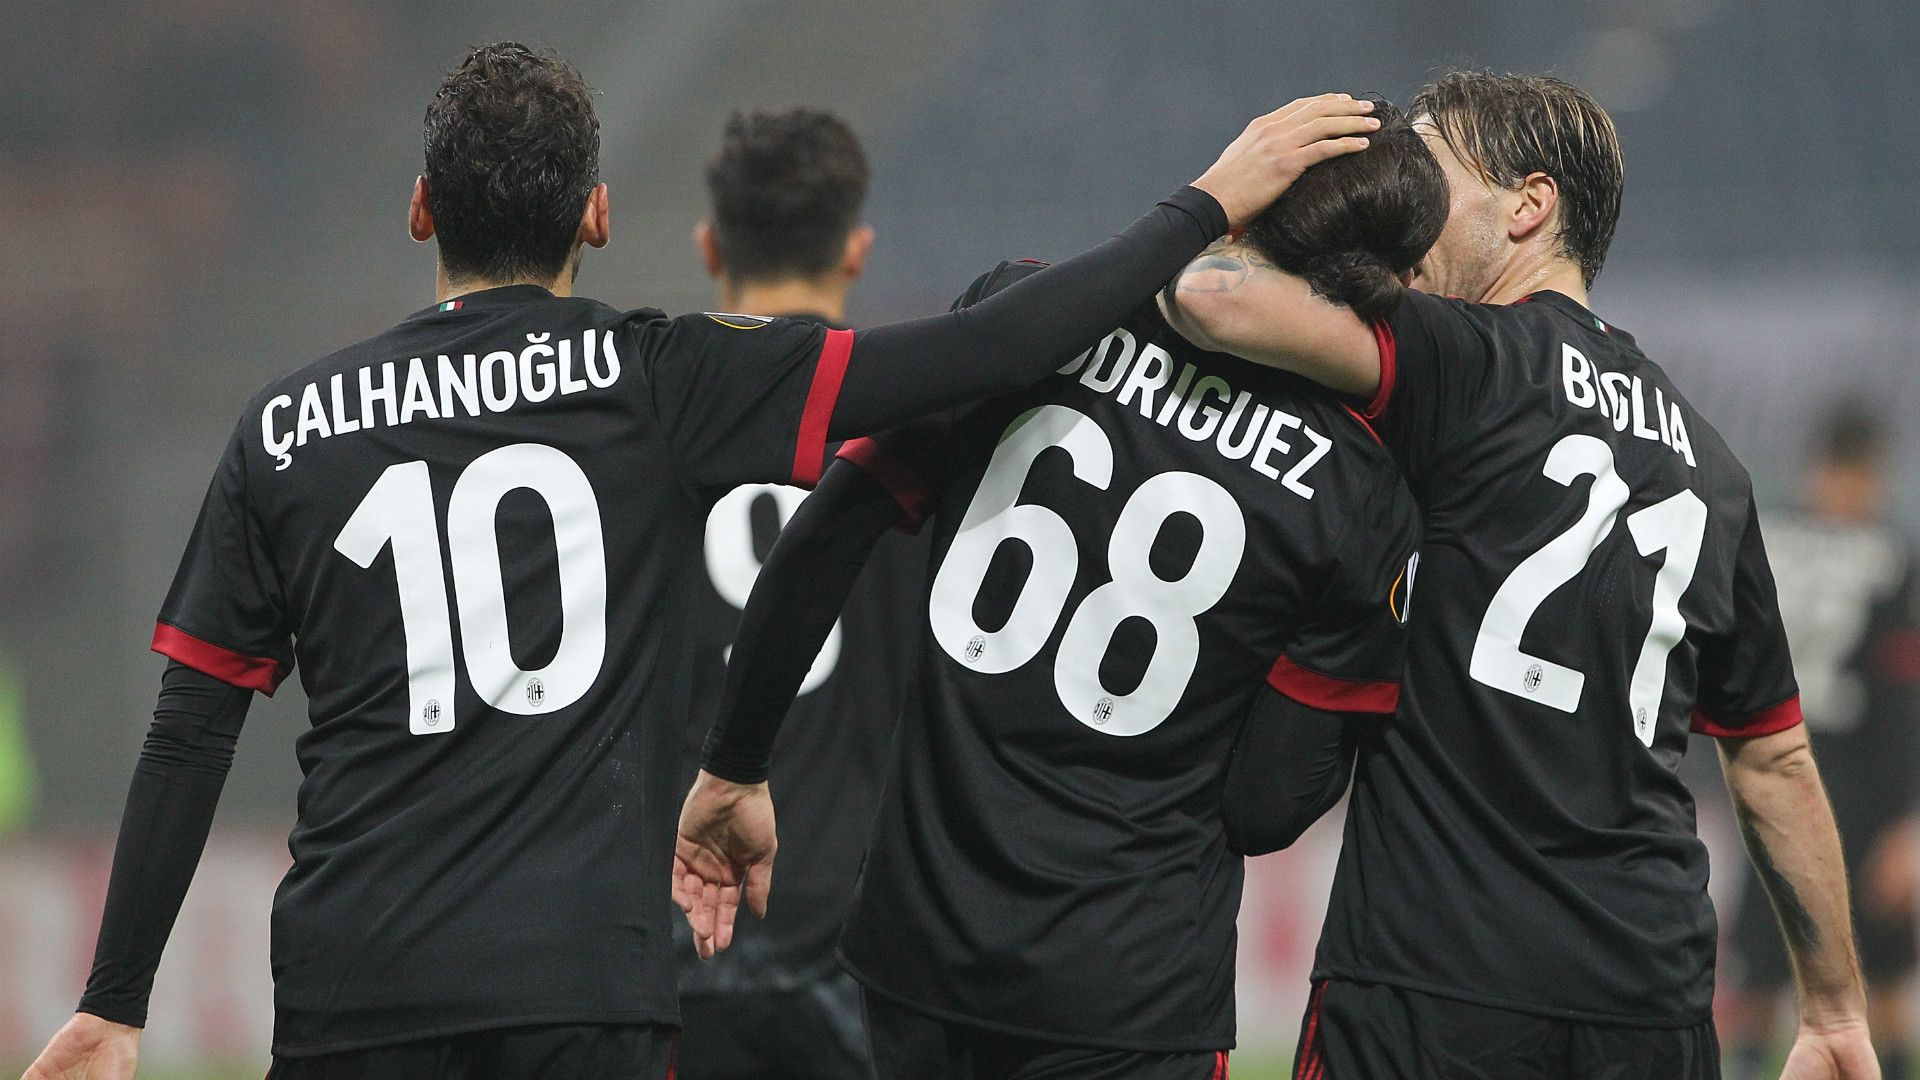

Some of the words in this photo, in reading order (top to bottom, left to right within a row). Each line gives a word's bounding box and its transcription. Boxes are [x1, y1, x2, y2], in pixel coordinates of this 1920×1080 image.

[262, 329, 621, 471] ÇALHANOĞLU
[1056, 327, 1333, 500] DRIGUEZ
[1562, 342, 1696, 468] BIGLIA
[334, 443, 606, 735] 10
[929, 404, 1246, 736] 68
[1470, 434, 1708, 748] 21
